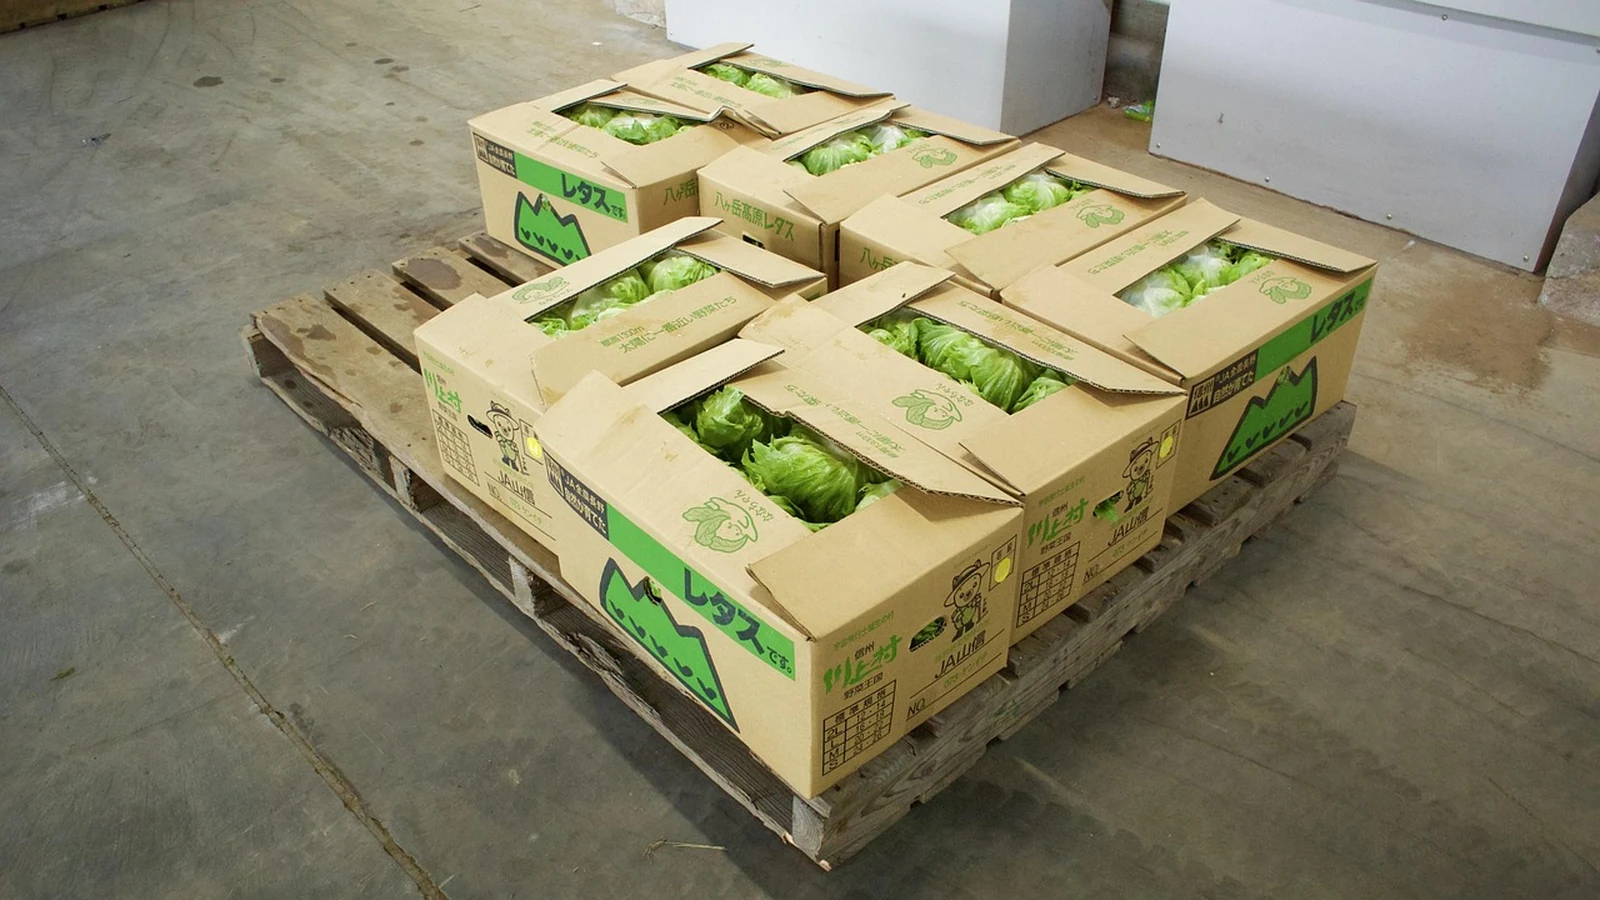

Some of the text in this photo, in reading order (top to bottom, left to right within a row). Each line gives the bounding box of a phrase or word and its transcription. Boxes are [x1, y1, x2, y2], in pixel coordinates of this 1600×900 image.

[618, 295, 738, 355] 太陽に一番近い野菜たち
[1027, 498, 1090, 549] 川上村
[823, 634, 903, 695] 川上村
[854, 641, 876, 661] 信州
[844, 672, 884, 701] 野菜王国
